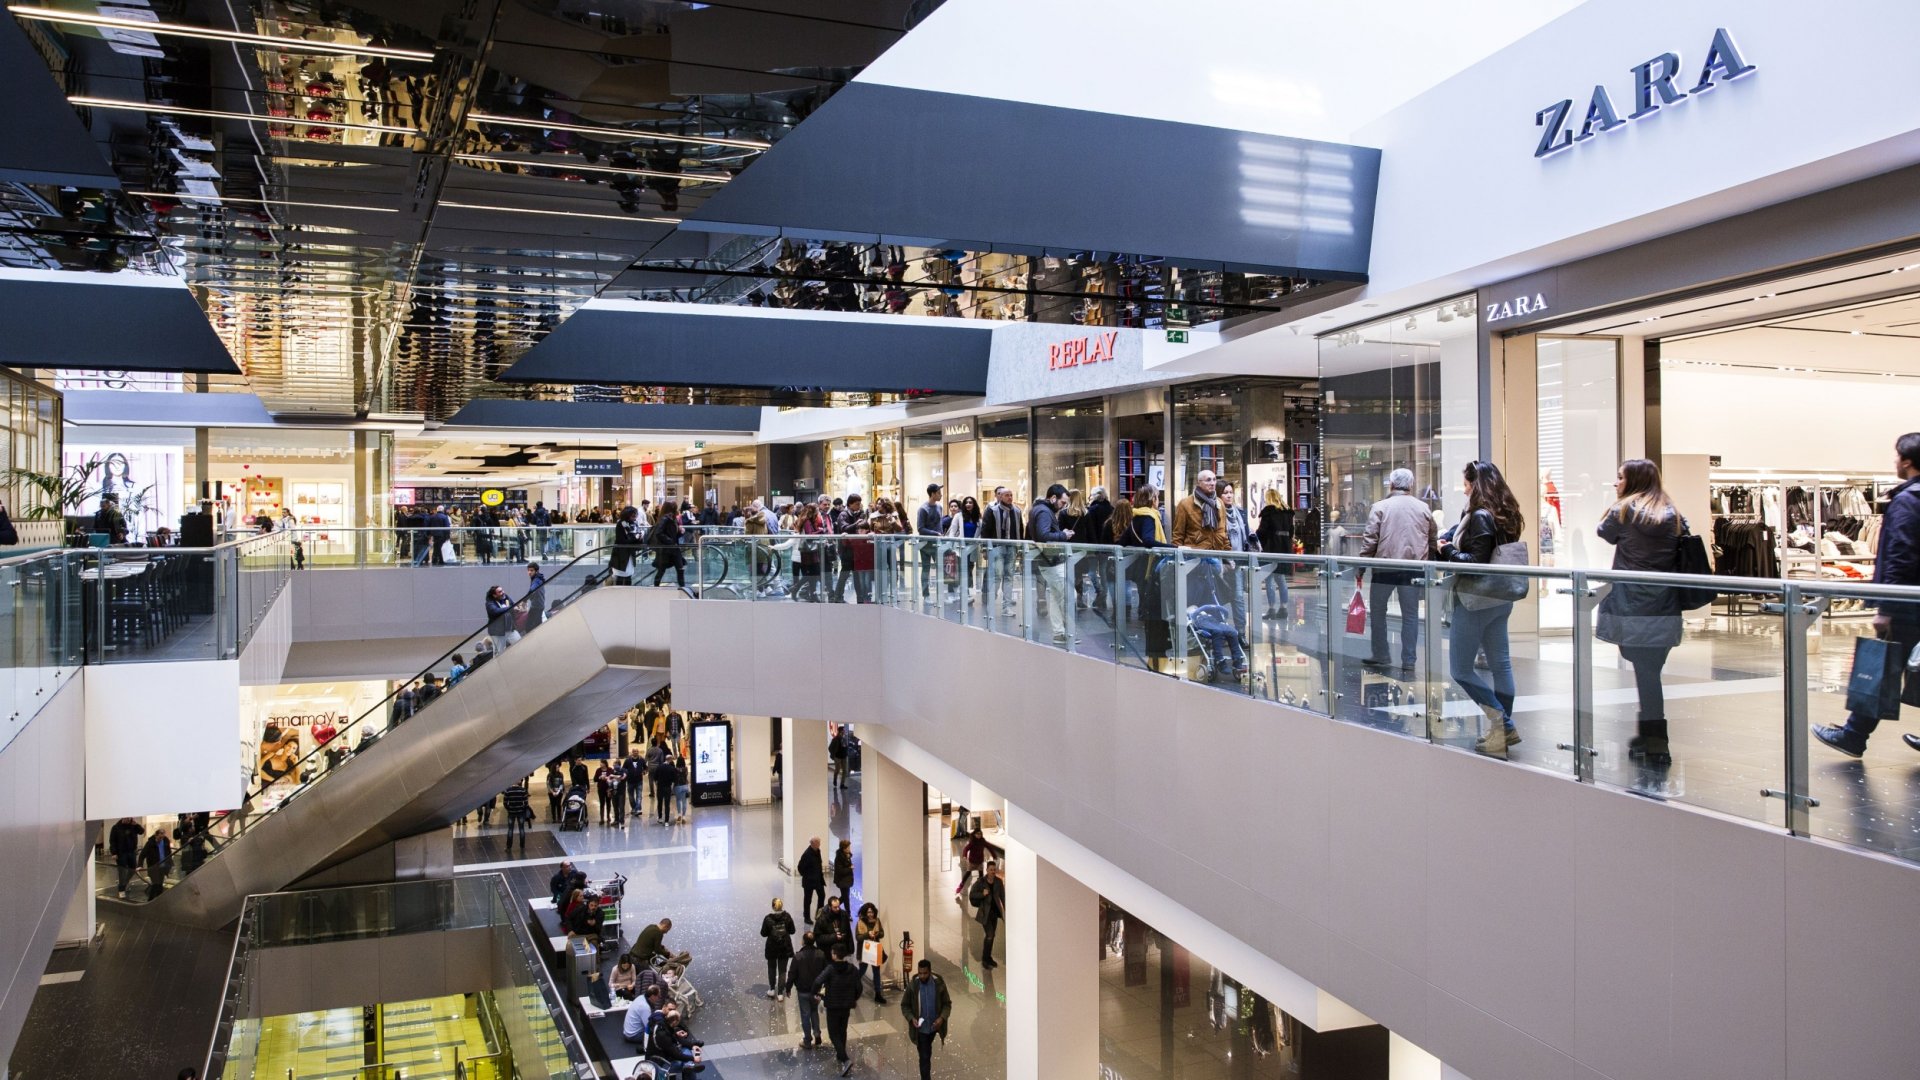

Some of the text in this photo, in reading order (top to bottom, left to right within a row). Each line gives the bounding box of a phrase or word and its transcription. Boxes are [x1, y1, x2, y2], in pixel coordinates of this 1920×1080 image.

[1535, 27, 1756, 158] ZARA
[1486, 292, 1548, 322] ZARA
[1049, 330, 1118, 371] REPLAY
